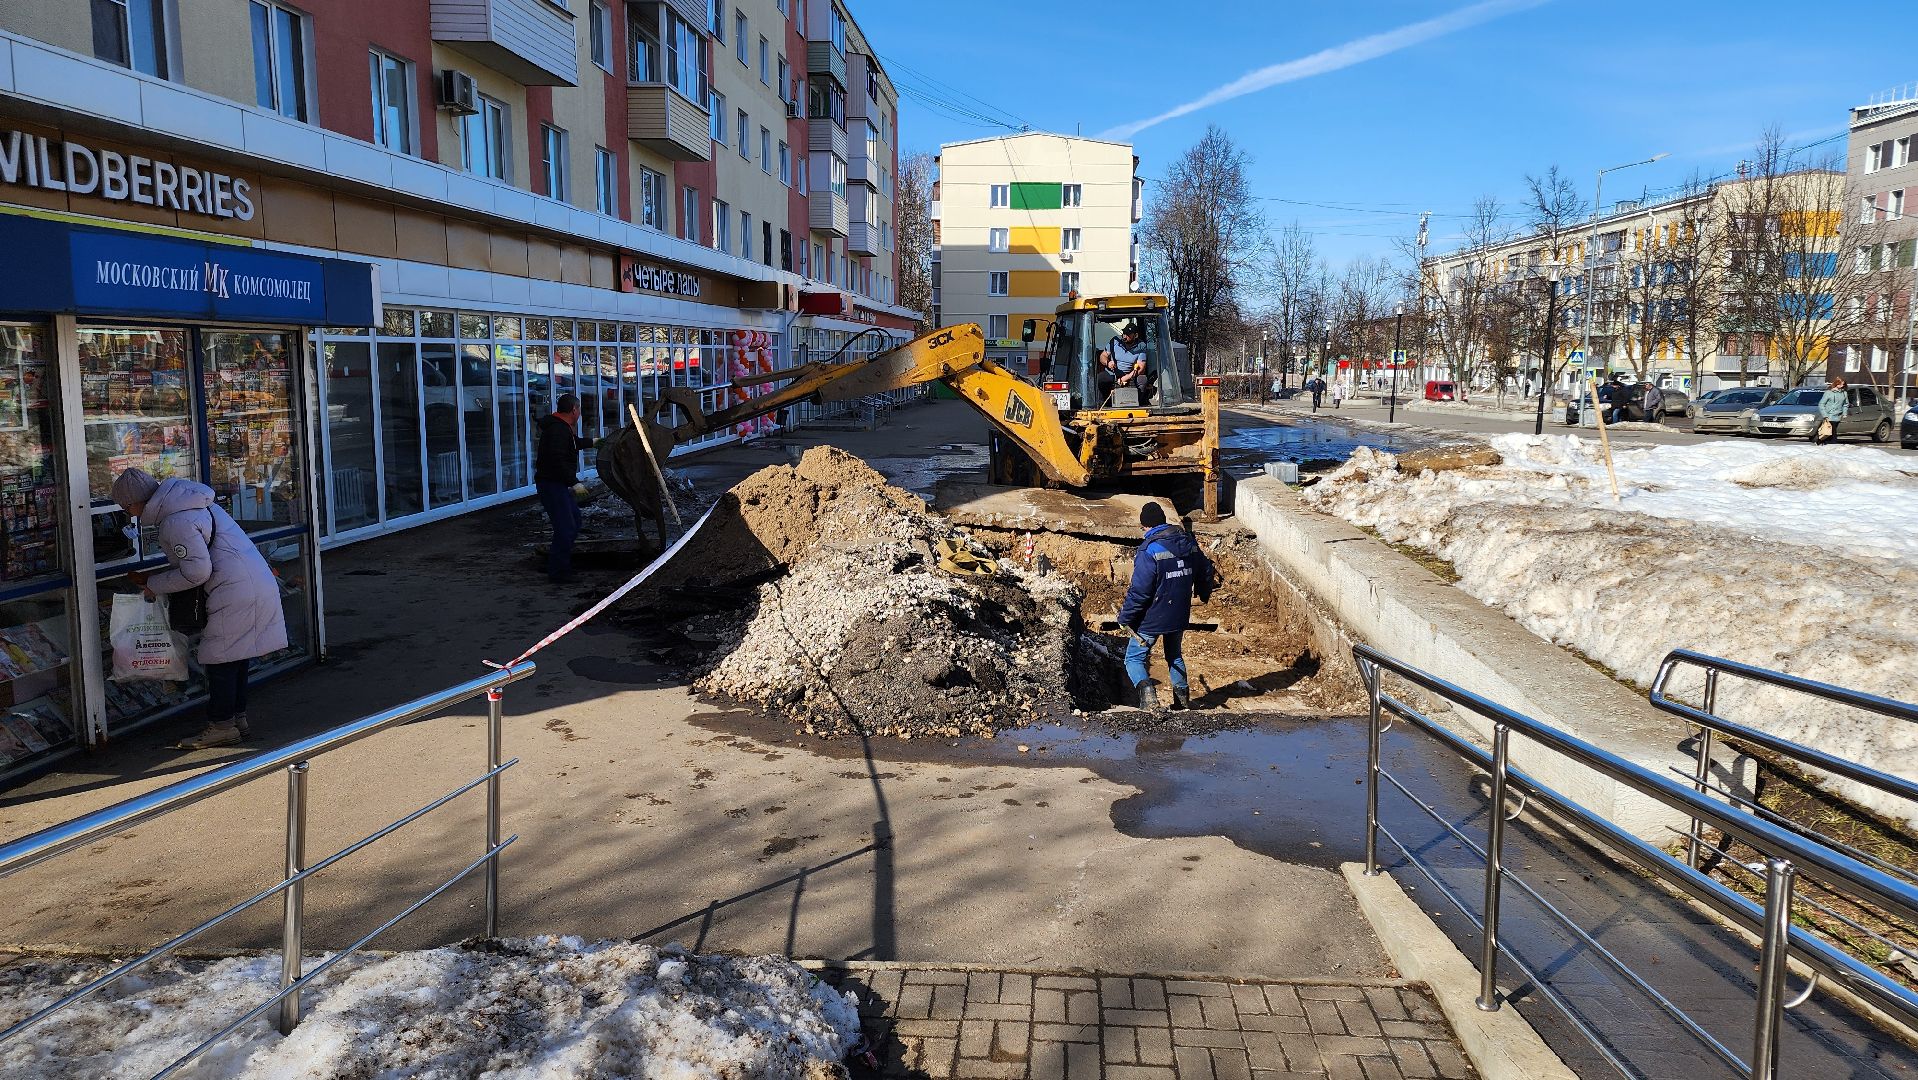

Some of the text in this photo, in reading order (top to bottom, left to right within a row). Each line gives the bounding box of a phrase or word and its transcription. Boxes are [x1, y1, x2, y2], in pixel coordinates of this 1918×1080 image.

[96, 260, 199, 292] МОСКОВСКИЙ
[233, 274, 311, 303] КОМСОМОЛЕЦ
[677, 273, 700, 296] лапы
[1006, 394, 1031, 426] JCB
